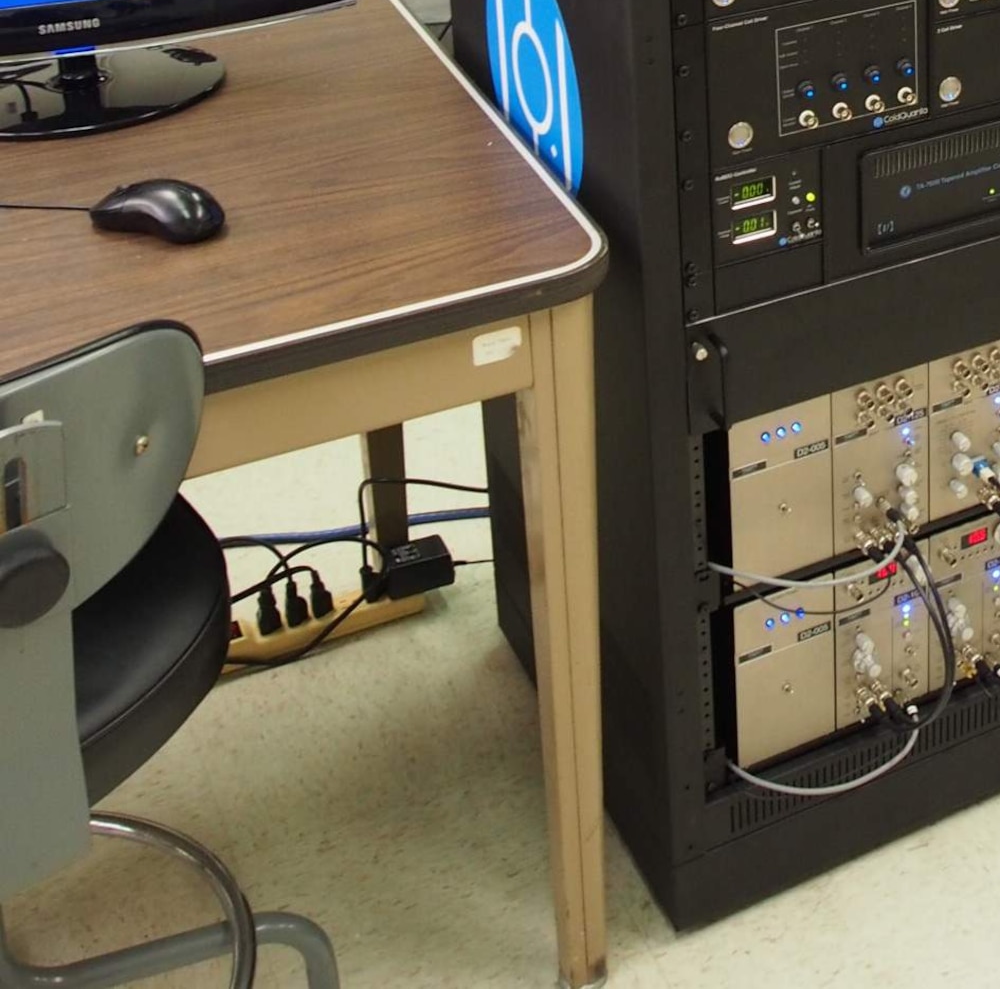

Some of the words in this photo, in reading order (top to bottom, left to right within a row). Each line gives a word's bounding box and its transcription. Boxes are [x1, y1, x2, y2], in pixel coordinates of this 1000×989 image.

[38, 17, 100, 35] SAMSUNG
[883, 107, 929, 124] ColdQuanta
[796, 441, 826, 457] D2-005
